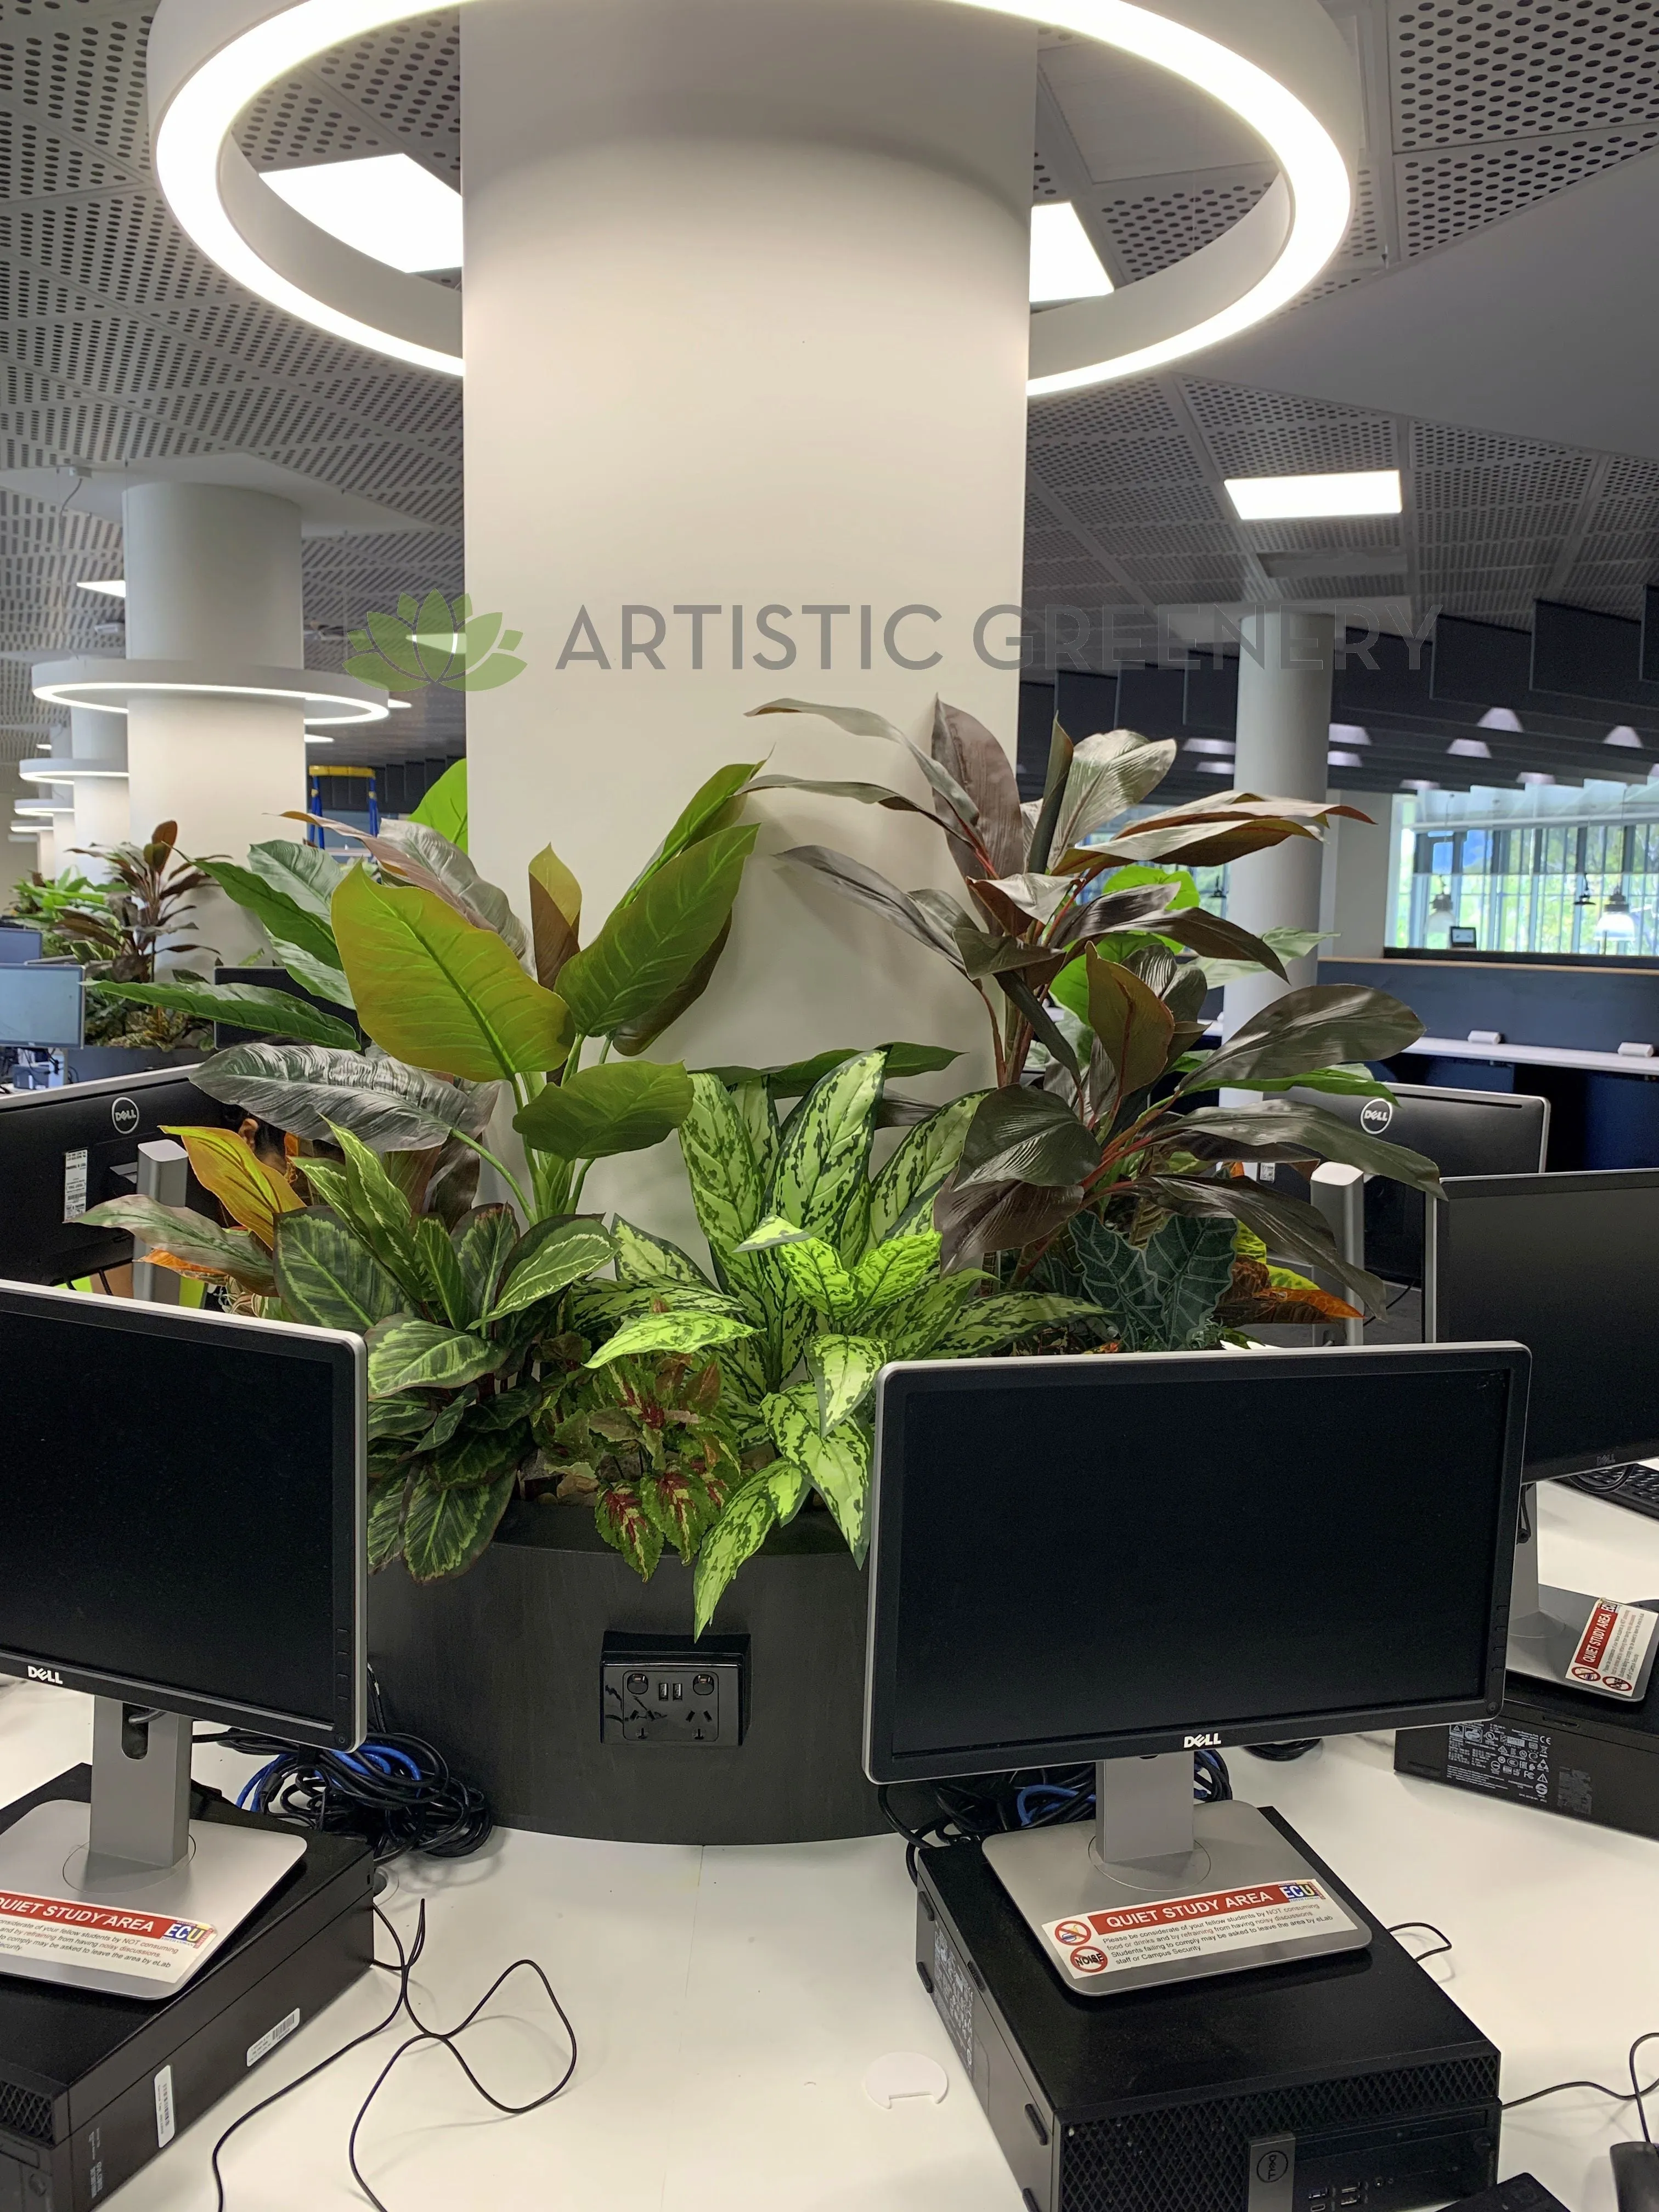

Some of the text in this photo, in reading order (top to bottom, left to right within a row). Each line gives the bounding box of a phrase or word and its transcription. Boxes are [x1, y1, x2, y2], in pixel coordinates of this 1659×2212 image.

[115, 1109, 137, 1121] DELL
[1364, 1109, 1388, 1121] DELL
[1583, 1613, 1612, 1663] QUIET STUDY AREA
[27, 1666, 63, 1684] DELL
[1183, 1733, 1221, 1748] DELL
[1279, 1884, 1315, 1898] ECU
[1107, 1891, 1273, 1927] QUIET STUDY AREA
[42, 1905, 105, 1923] STUDY
[102, 1915, 154, 1932] AREA
[1139, 1927, 1180, 1938] considerate
[1227, 1914, 1256, 1922] students
[1284, 1904, 1320, 1912] consuming
[164, 1923, 205, 1942] ECU
[1181, 1928, 1214, 1938] refraining
[1231, 1921, 1255, 1929] having
[7, 1937, 32, 1945] comply
[24, 1931, 57, 1941] refraining
[75, 1939, 99, 1948] having
[81, 1932, 111, 1941] students
[140, 1942, 179, 1954] consuming
[1111, 1948, 1143, 1957] Students
[1175, 1938, 1200, 1946] comply
[1075, 1953, 1104, 1967] NOISE
[1141, 1950, 1172, 1960] Campus
[1172, 1946, 1201, 1954] Security
[1268, 2154, 1277, 2180] DELL
